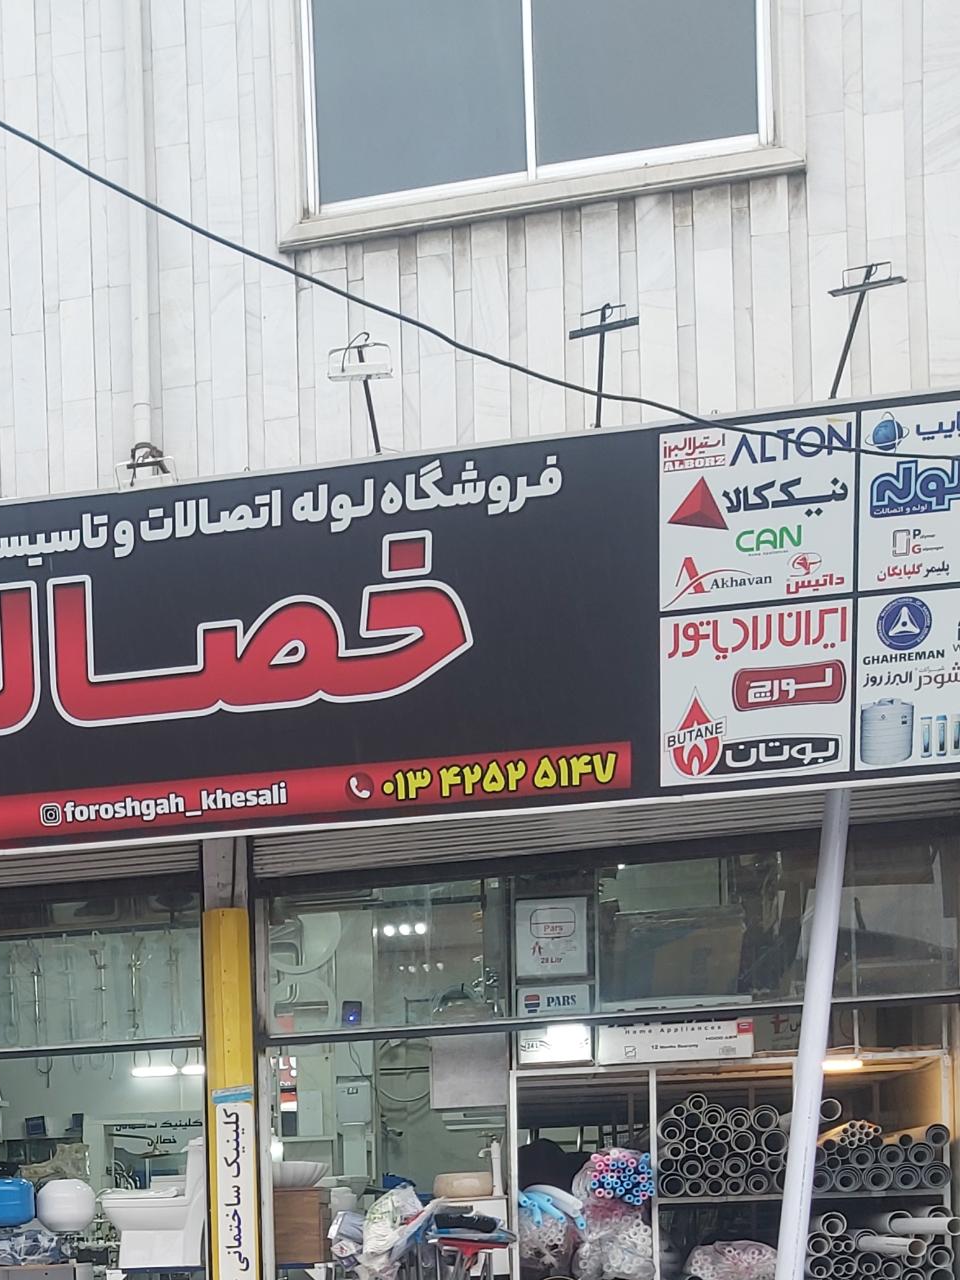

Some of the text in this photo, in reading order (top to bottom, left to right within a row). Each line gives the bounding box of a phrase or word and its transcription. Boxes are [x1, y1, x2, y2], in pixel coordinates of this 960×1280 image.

[729, 421, 853, 467] ALTON
[663, 456, 726, 472] ALBORZ
[380, 455, 563, 516] فروشگاه
[139, 489, 282, 543] اتصالات
[291, 478, 375, 533] لوله
[113, 519, 136, 558] و
[735, 524, 802, 553] CAN
[710, 574, 773, 591] Akhavan
[785, 573, 846, 596] داتیس
[876, 560, 950, 582] پلیمر گلپایگان
[862, 649, 945, 666] GHAHREMAN
[667, 721, 724, 749] BUTANE
[725, 739, 836, 768] بوتان
[63, 781, 288, 824] foroshgah_khesali
[546, 994, 577, 1007] PARS
[625, 1025, 722, 1035] Home Appliances
[222, 1108, 246, 1179] کلینیک
[224, 1184, 251, 1272] ساختمانی
